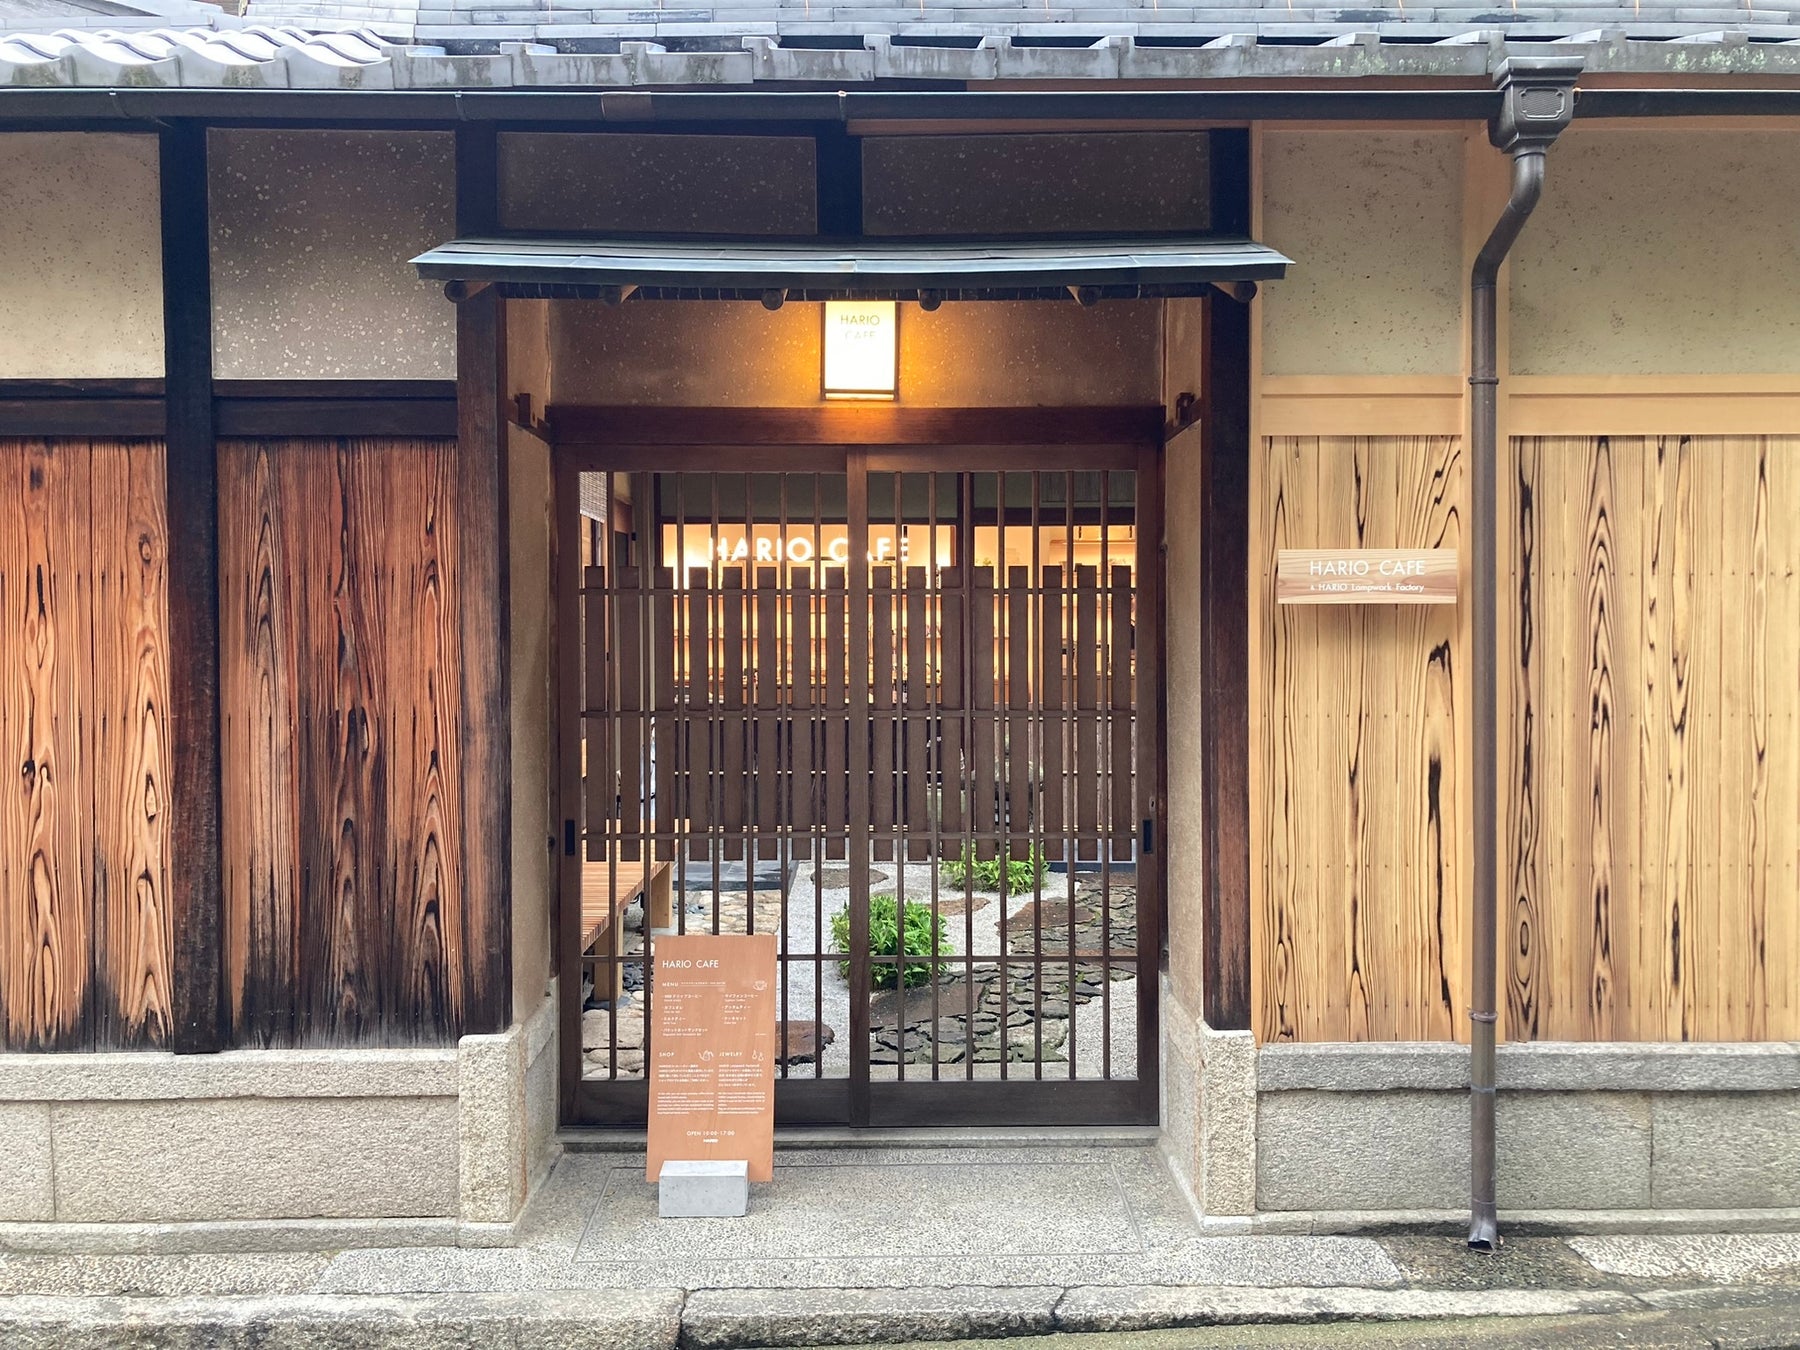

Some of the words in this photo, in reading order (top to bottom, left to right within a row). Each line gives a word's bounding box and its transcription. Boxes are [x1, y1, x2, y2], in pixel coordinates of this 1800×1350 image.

[840, 314, 880, 326] HARIO
[709, 537, 813, 562] HARIO
[1309, 560, 1369, 576] HARIO
[1379, 560, 1425, 576] CAFE
[1318, 583, 1348, 591] HARIO
[1351, 583, 1392, 593] Lampwork
[1395, 583, 1424, 593] Factory
[662, 959, 692, 969] HARIO
[696, 959, 719, 969] CAFE
